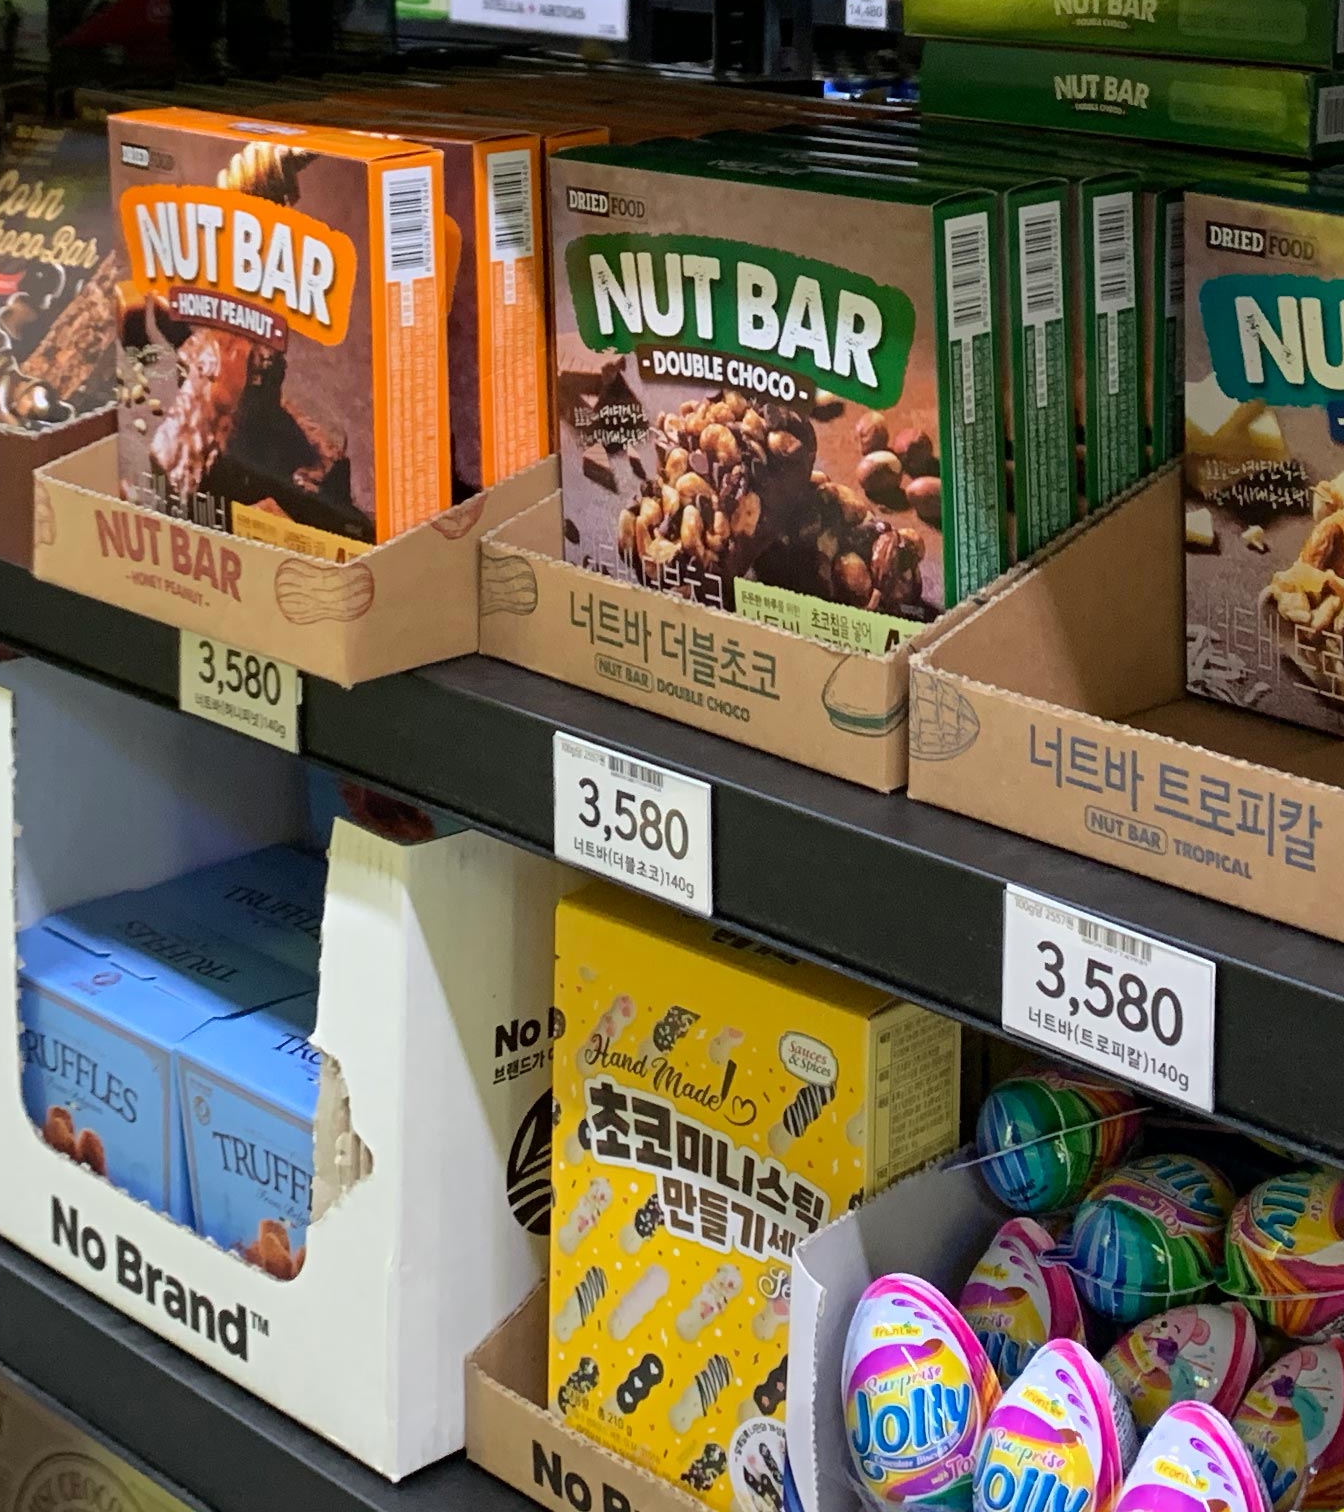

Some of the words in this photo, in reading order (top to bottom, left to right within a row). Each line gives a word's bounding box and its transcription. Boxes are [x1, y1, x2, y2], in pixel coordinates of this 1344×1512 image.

[1054, 74, 1100, 101] NUT
[1104, 76, 1150, 110] BAR
[568, 188, 609, 217] DRIED
[610, 193, 647, 221] FOOD
[135, 202, 224, 284] NUT
[233, 208, 335, 326] BAR
[1208, 223, 1264, 257] DRIED
[1268, 232, 1316, 262] FOOD
[178, 293, 219, 319] HONEY
[221, 302, 274, 338] PEANUT
[588, 251, 721, 340] NUT
[736, 262, 884, 390] BAR
[652, 352, 724, 384] DOUBLE
[727, 357, 796, 404] CHOCO
[96, 509, 169, 567] NUT
[171, 526, 242, 602] BAR
[198, 640, 281, 706] 3,580
[569, 590, 653, 659] 너트바
[659, 615, 781, 703] 더블초코
[599, 656, 623, 684] NUT
[625, 663, 650, 689] BAR
[656, 677, 705, 713] DOUBLE
[706, 692, 751, 725] CHOCO
[578, 777, 689, 861] 3,580
[1028, 721, 1143, 813] 너트바
[1157, 763, 1323, 877] 트로피칼
[1090, 810, 1126, 841] NUT
[1127, 822, 1163, 852] BAR
[1172, 838, 1254, 881] TROPICAL
[1036, 940, 1184, 1046] 3,580
[494, 1016, 541, 1060] No
[585, 1034, 649, 1081] Hand
[788, 1040, 828, 1064] Sauces
[1028, 1006, 1190, 1092] 너트바(트로피칼)140g
[589, 1081, 825, 1234] 초코미니스틱
[50, 1194, 106, 1272] No
[866, 1365, 941, 1396] Surprise
[852, 1383, 971, 1455] Jolly
[994, 1429, 1066, 1468] Surprise
[532, 1439, 592, 1512] No
